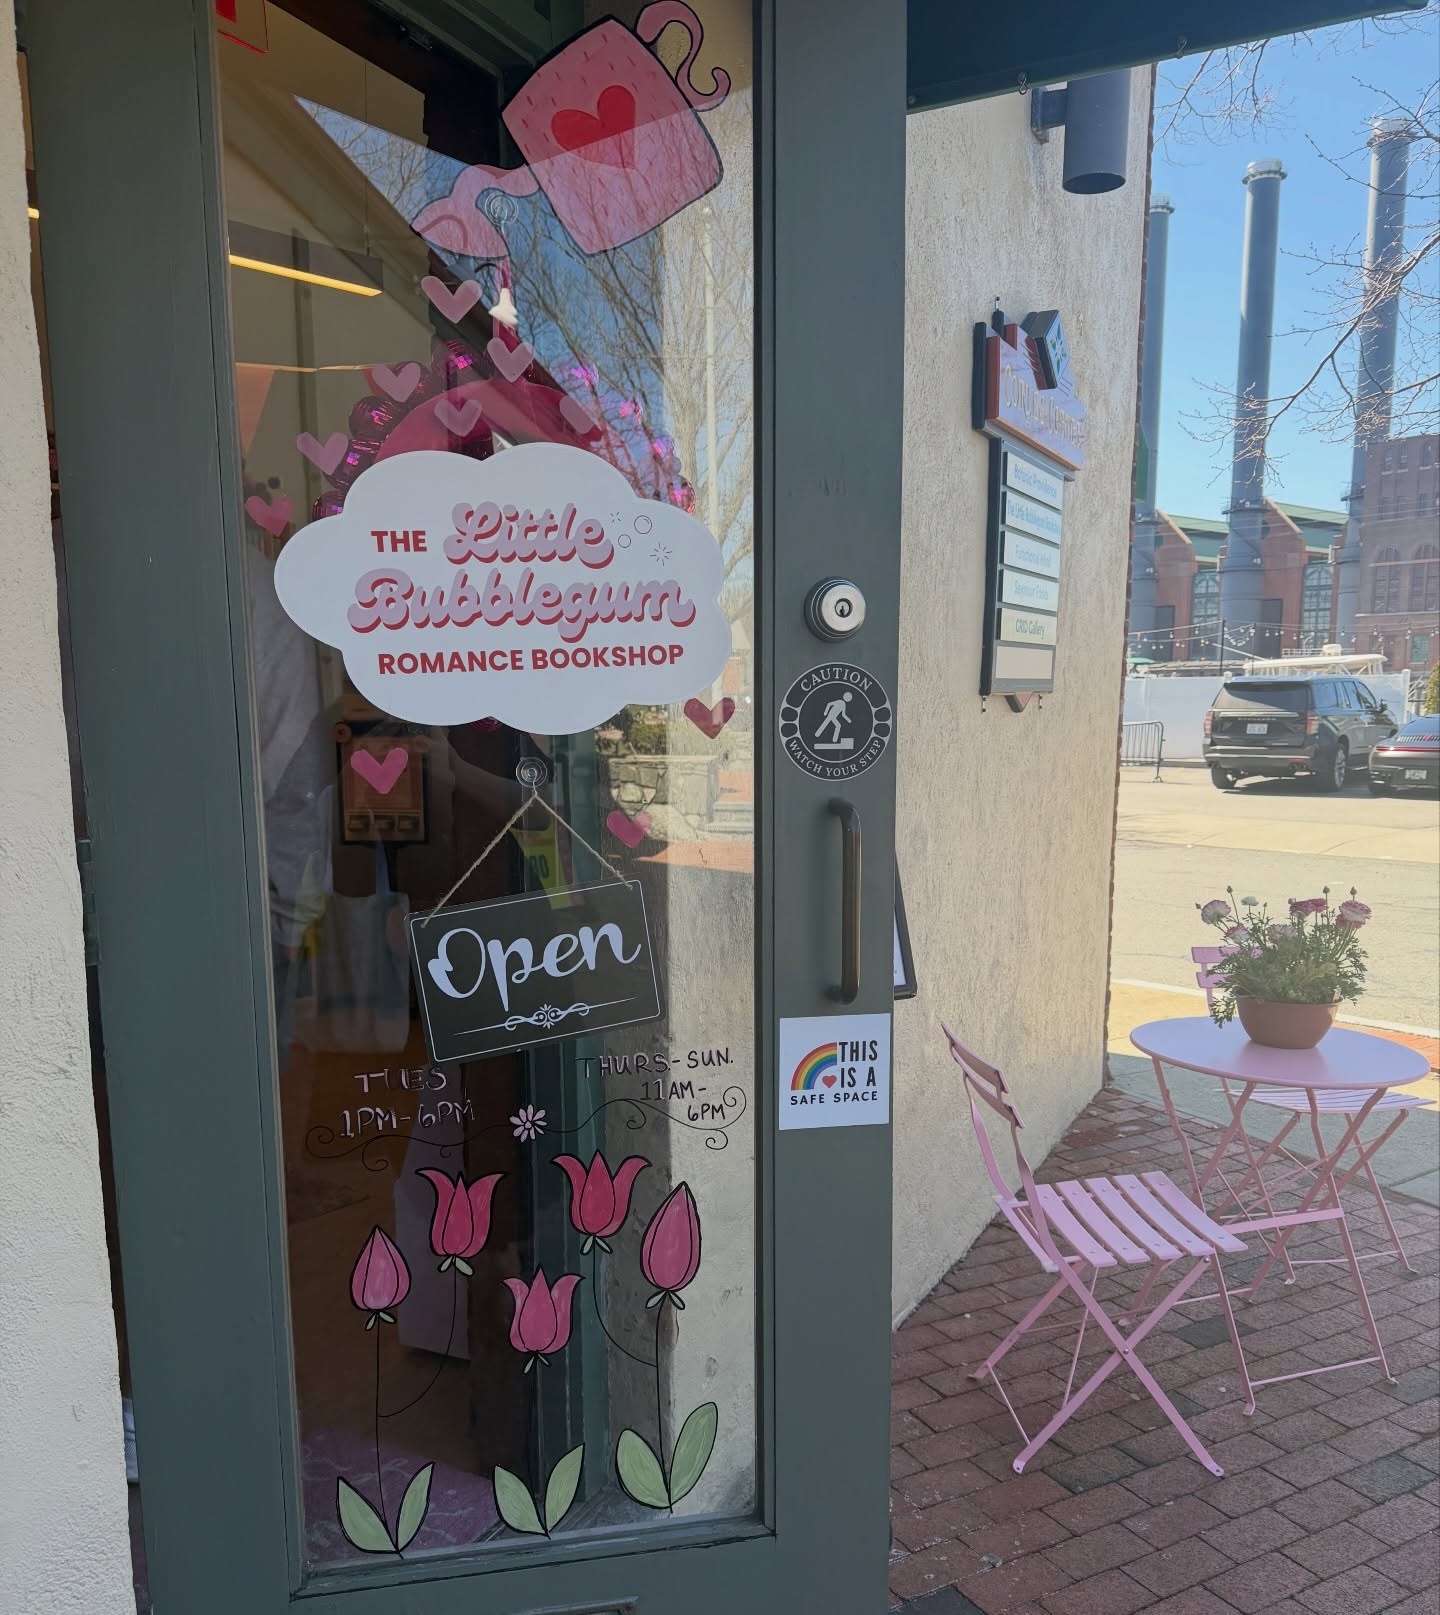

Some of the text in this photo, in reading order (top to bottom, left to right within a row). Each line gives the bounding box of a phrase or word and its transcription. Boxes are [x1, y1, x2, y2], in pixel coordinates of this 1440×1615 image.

[371, 501, 615, 569] THE Little
[346, 567, 696, 644] Bubblegum
[378, 644, 684, 675] ROMANCE BOOKSHOP
[800, 667, 873, 692] CAUTION
[789, 739, 881, 777] WATCH YOUR STEP
[428, 922, 642, 1011] Open
[839, 1040, 878, 1062] THIS
[841, 1066, 877, 1088] IS A
[687, 1103, 725, 1121] 6PM
[790, 1091, 878, 1106] SAFE SPACE
